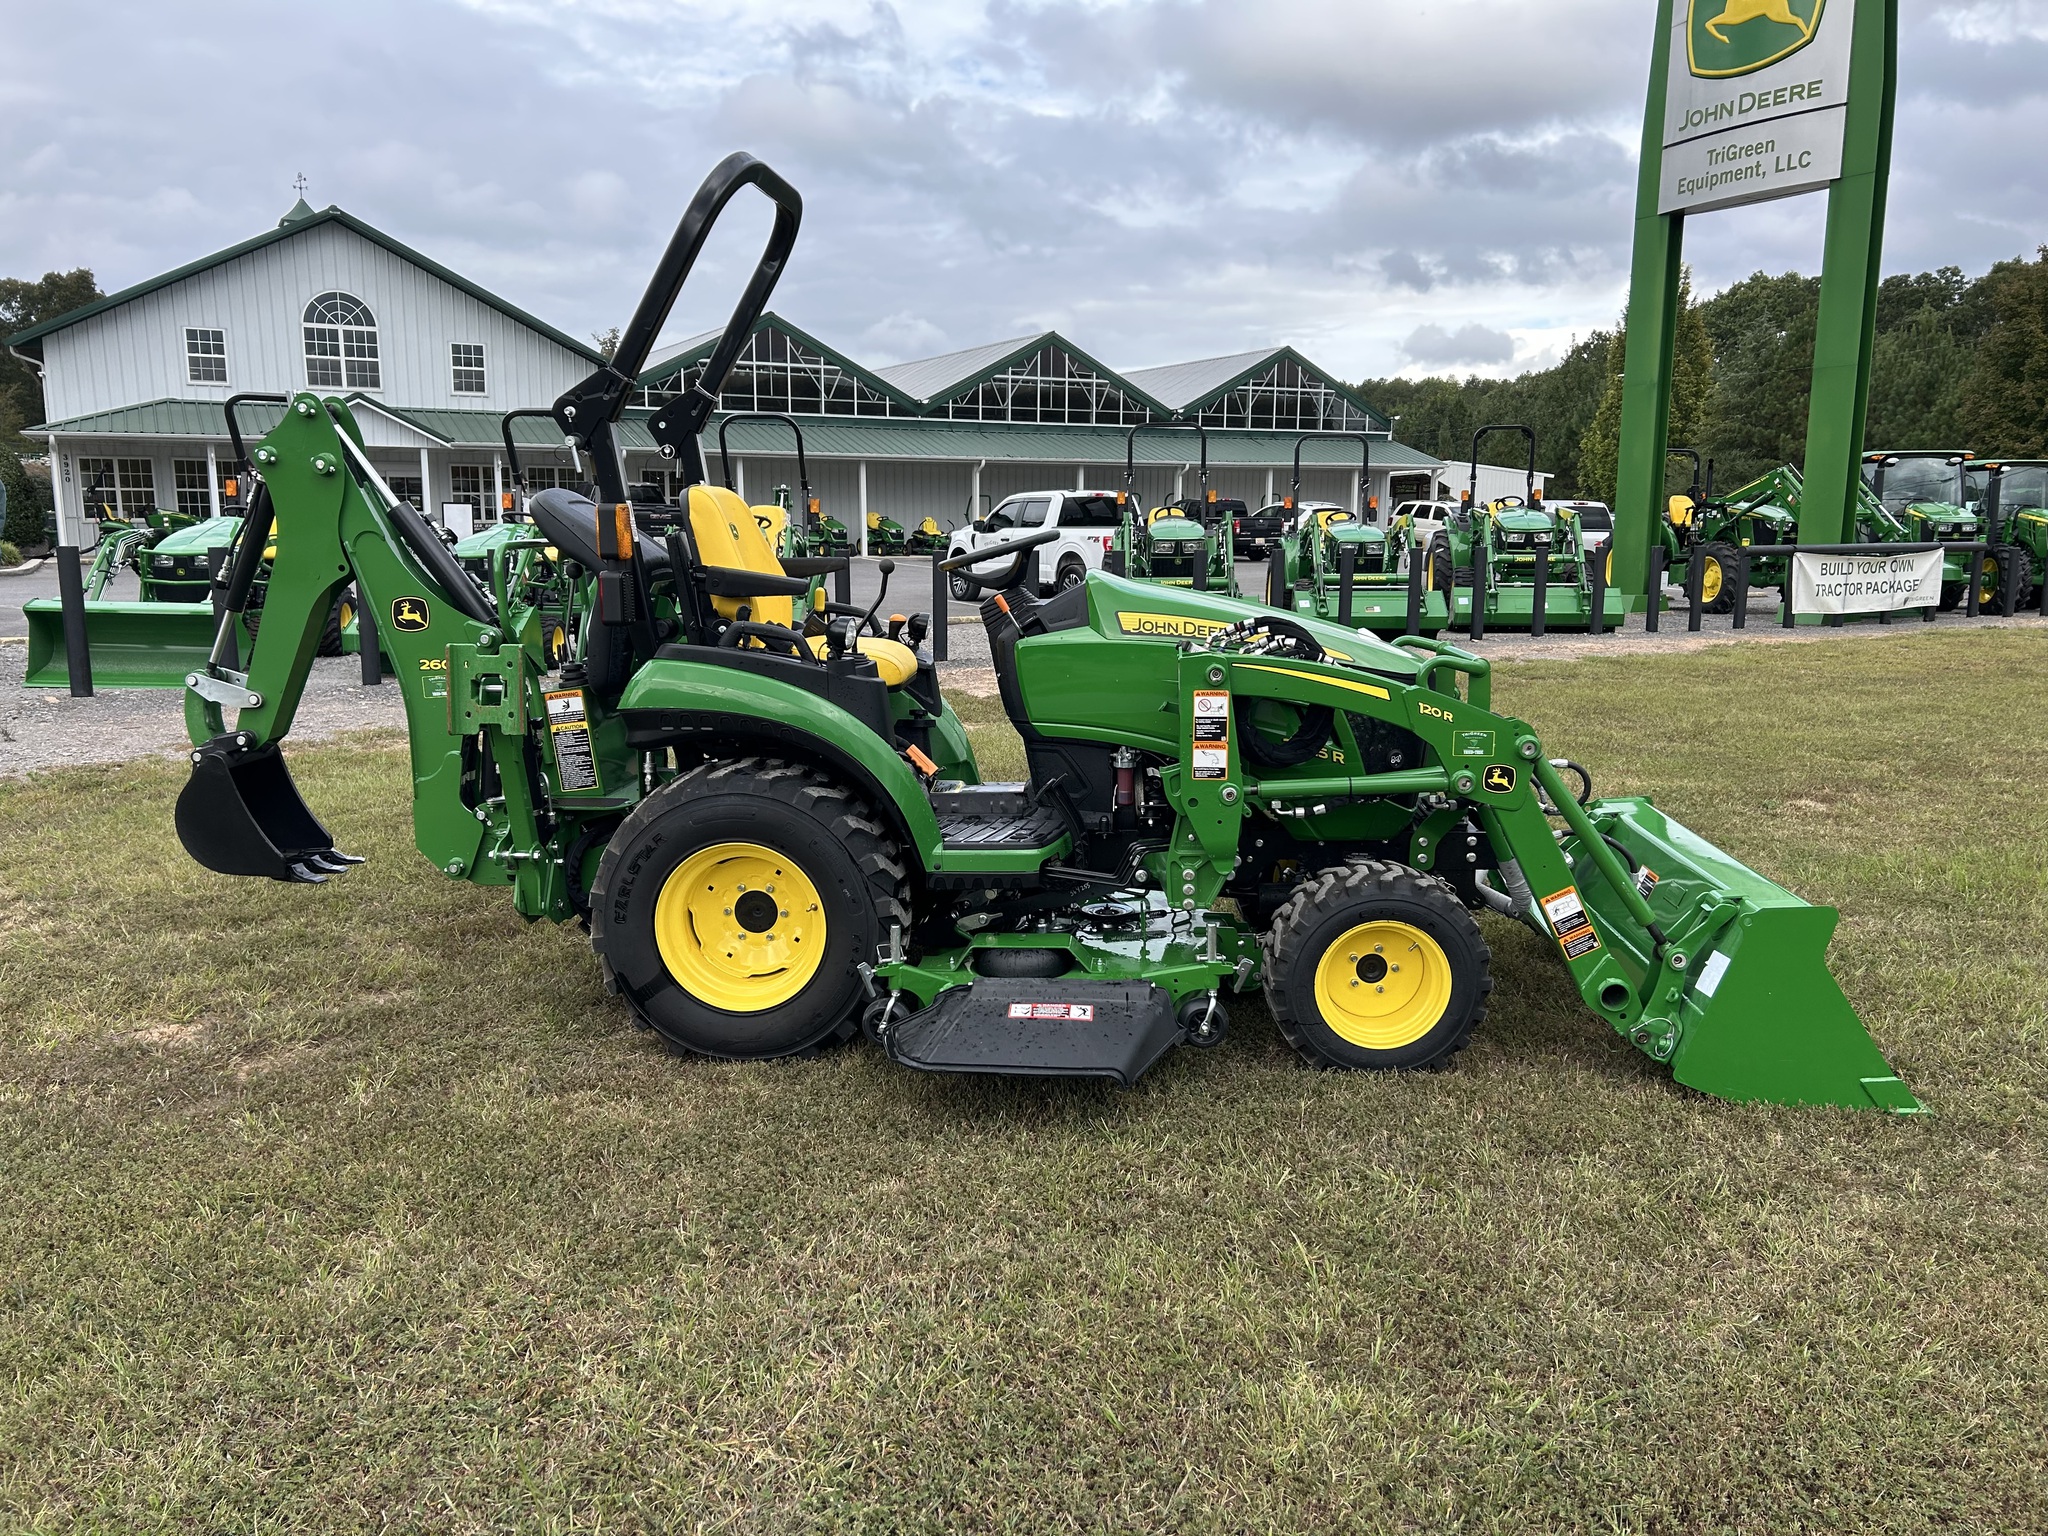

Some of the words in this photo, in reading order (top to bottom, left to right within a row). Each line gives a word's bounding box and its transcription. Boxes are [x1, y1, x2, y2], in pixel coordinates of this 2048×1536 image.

[1678, 100, 1734, 132] JOHN
[1738, 79, 1823, 115] DEERE
[1707, 139, 1775, 166] TriGreen
[1677, 162, 1766, 195] Equipment,
[1774, 150, 1812, 174] LLC
[62, 453, 71, 483] 3920
[1820, 562, 1854, 576] BUILD
[1857, 560, 1887, 575] YOUR
[1890, 559, 1915, 573] OWN
[1815, 582, 1863, 597] TRACTOR
[1132, 618, 1179, 634] JOHN
[1184, 621, 1224, 637] DEE
[553, 691, 579, 699] WARNING
[1418, 702, 1442, 718] 120
[560, 723, 584, 731] CAUTION
[614, 832, 668, 925] CARLSTAR
[1550, 888, 1572, 901] WARNING
[1569, 928, 1591, 940] WARNING
